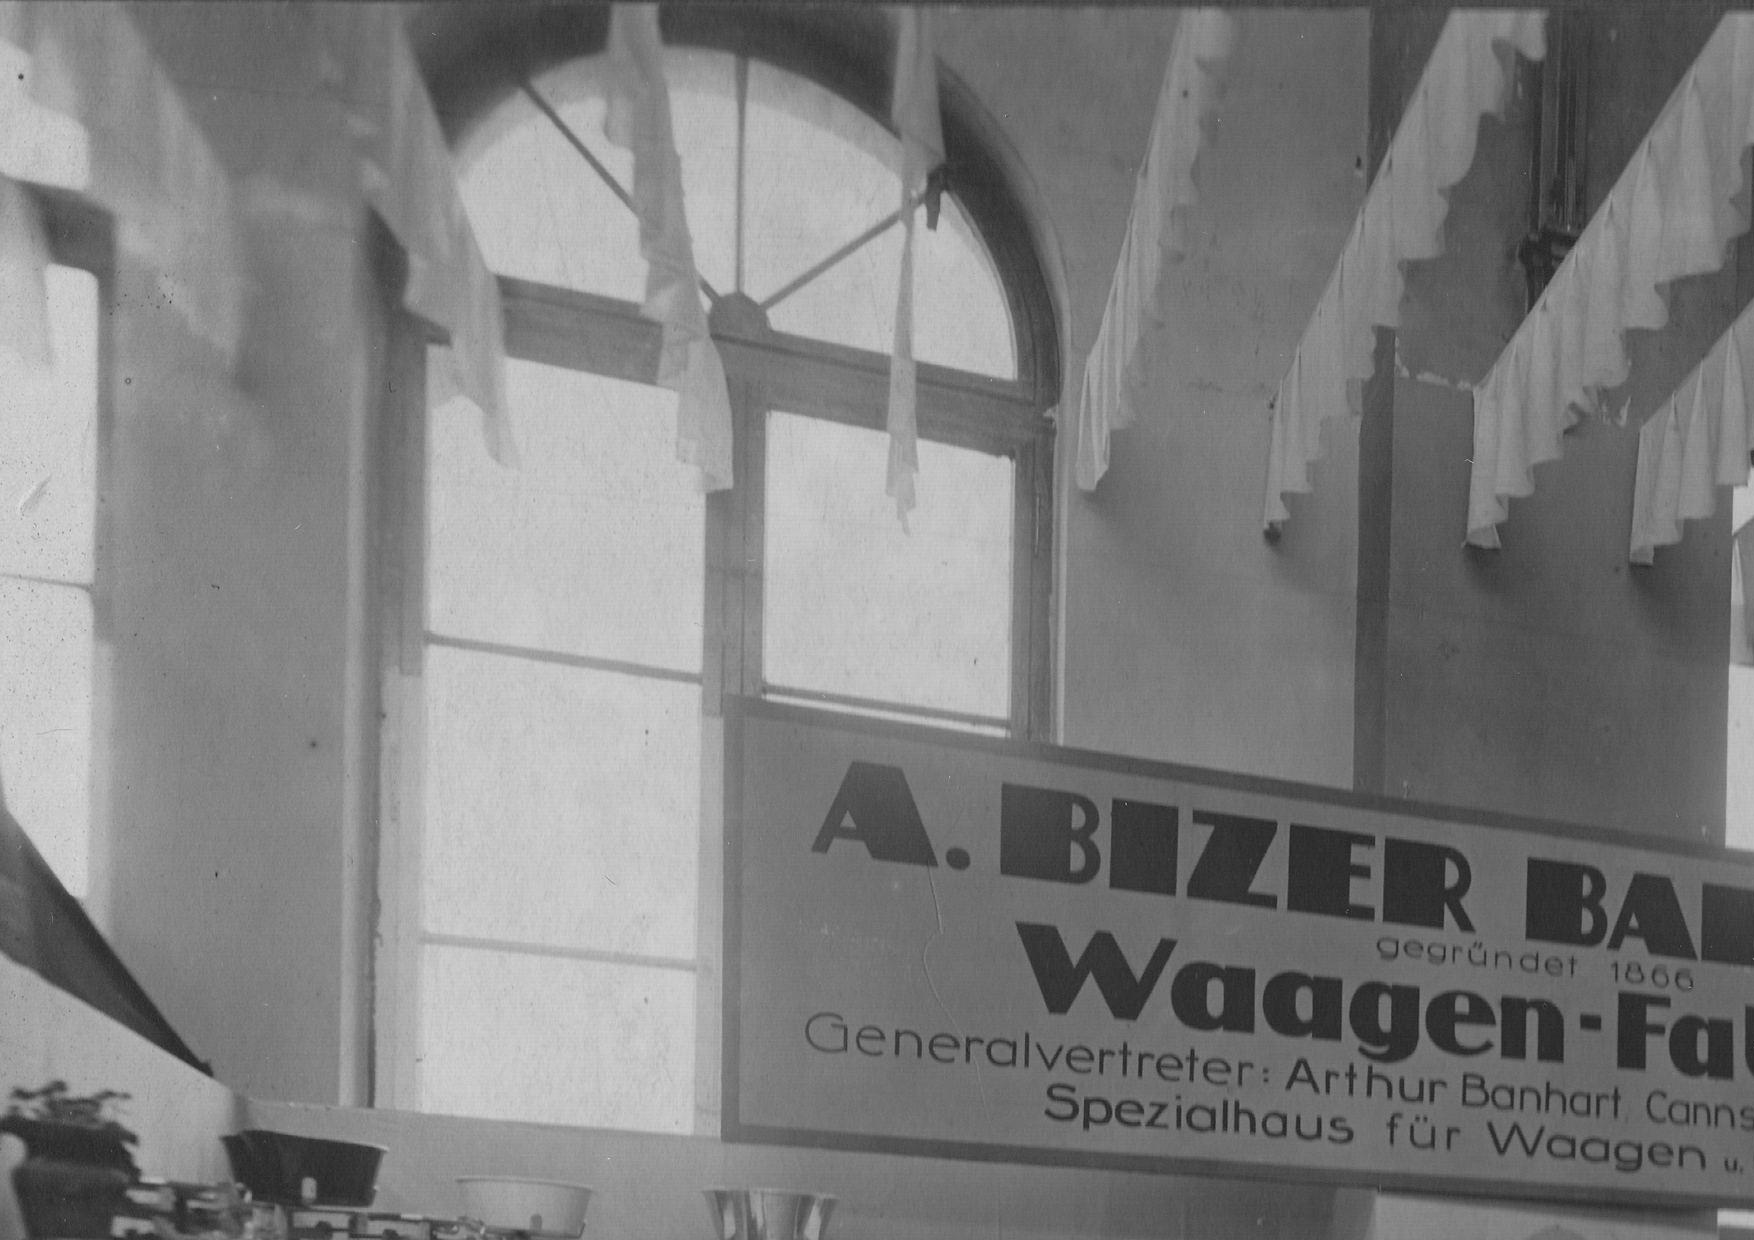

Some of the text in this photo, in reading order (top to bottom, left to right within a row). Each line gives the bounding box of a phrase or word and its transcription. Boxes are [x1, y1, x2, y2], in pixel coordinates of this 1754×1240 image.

[811, 761, 971, 871] A.
[1000, 782, 1477, 933] BIZER
[1376, 936, 1695, 992] gegründet 1866
[804, 1012, 1270, 1088] Generalvertreter:
[1285, 1057, 1448, 1106] Arthur
[1044, 1083, 1356, 1144] Spezialhaus
[1386, 1112, 1461, 1152] für
[1487, 1121, 1707, 1173] Waagen
